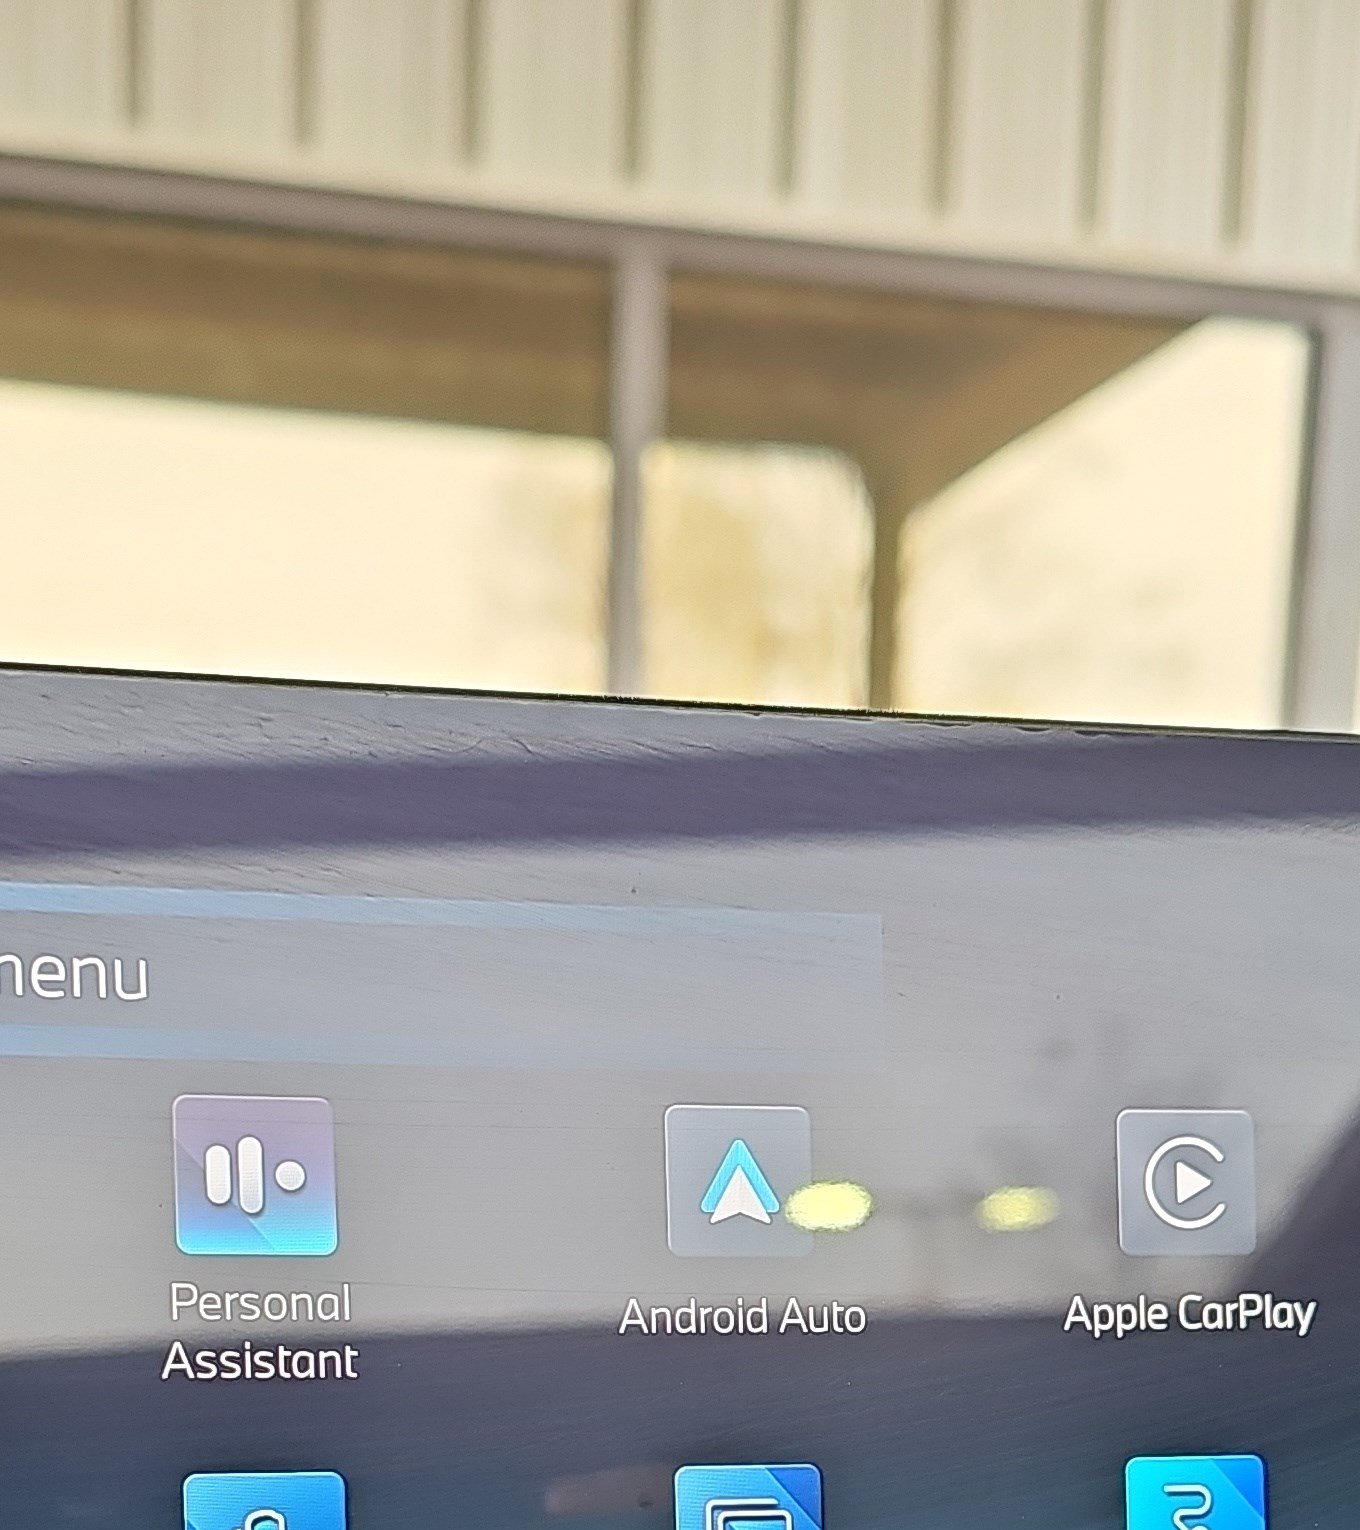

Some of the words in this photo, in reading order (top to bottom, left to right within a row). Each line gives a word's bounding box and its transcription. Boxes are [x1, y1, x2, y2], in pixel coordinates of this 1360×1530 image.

[169, 1282, 351, 1323] Personal
[618, 1297, 769, 1335] Android
[778, 1299, 868, 1335] Auto
[1063, 1294, 1169, 1337] Apple
[1178, 1294, 1317, 1335] CarPlay
[160, 1342, 360, 1382] Assistant
